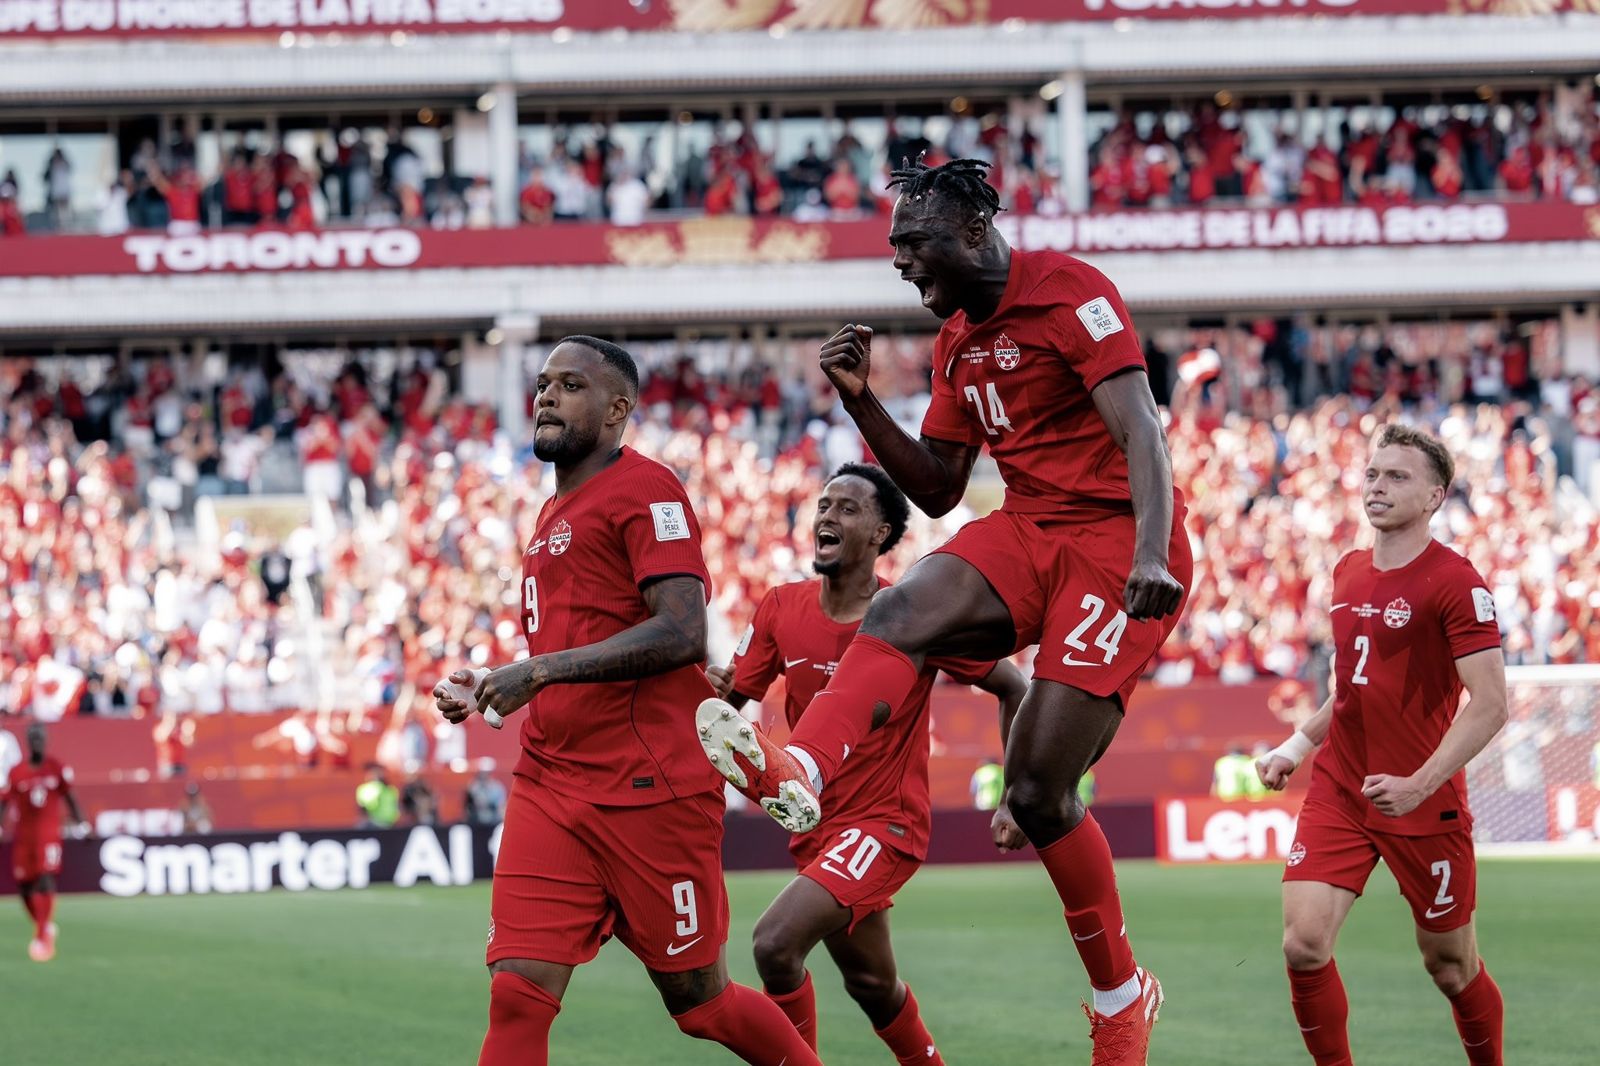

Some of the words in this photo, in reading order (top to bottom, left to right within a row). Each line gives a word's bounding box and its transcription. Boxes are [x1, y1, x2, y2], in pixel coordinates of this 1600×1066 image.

[61, 0, 114, 31] DU
[117, 0, 246, 30] MONDE
[250, 0, 297, 27] DE
[300, 0, 348, 26] LA
[351, 0, 432, 25] FIFA
[123, 229, 422, 272] TORONTO
[1021, 215, 1073, 250] DU
[1077, 213, 1199, 249] MONDE
[1203, 210, 1251, 247] DE
[1253, 208, 1300, 246] LA
[1302, 207, 1381, 245] FIFA
[1383, 204, 1508, 243] 2026
[964, 382, 1015, 436] 24
[525, 576, 539, 633] 9
[1063, 593, 1128, 665] 24
[1352, 635, 1370, 685] 2
[824, 828, 882, 881] 20
[1166, 799, 1297, 862] Len
[99, 832, 381, 897] Smarter
[394, 824, 475, 887] AI
[1431, 860, 1455, 906] 2
[672, 880, 698, 937] 9
